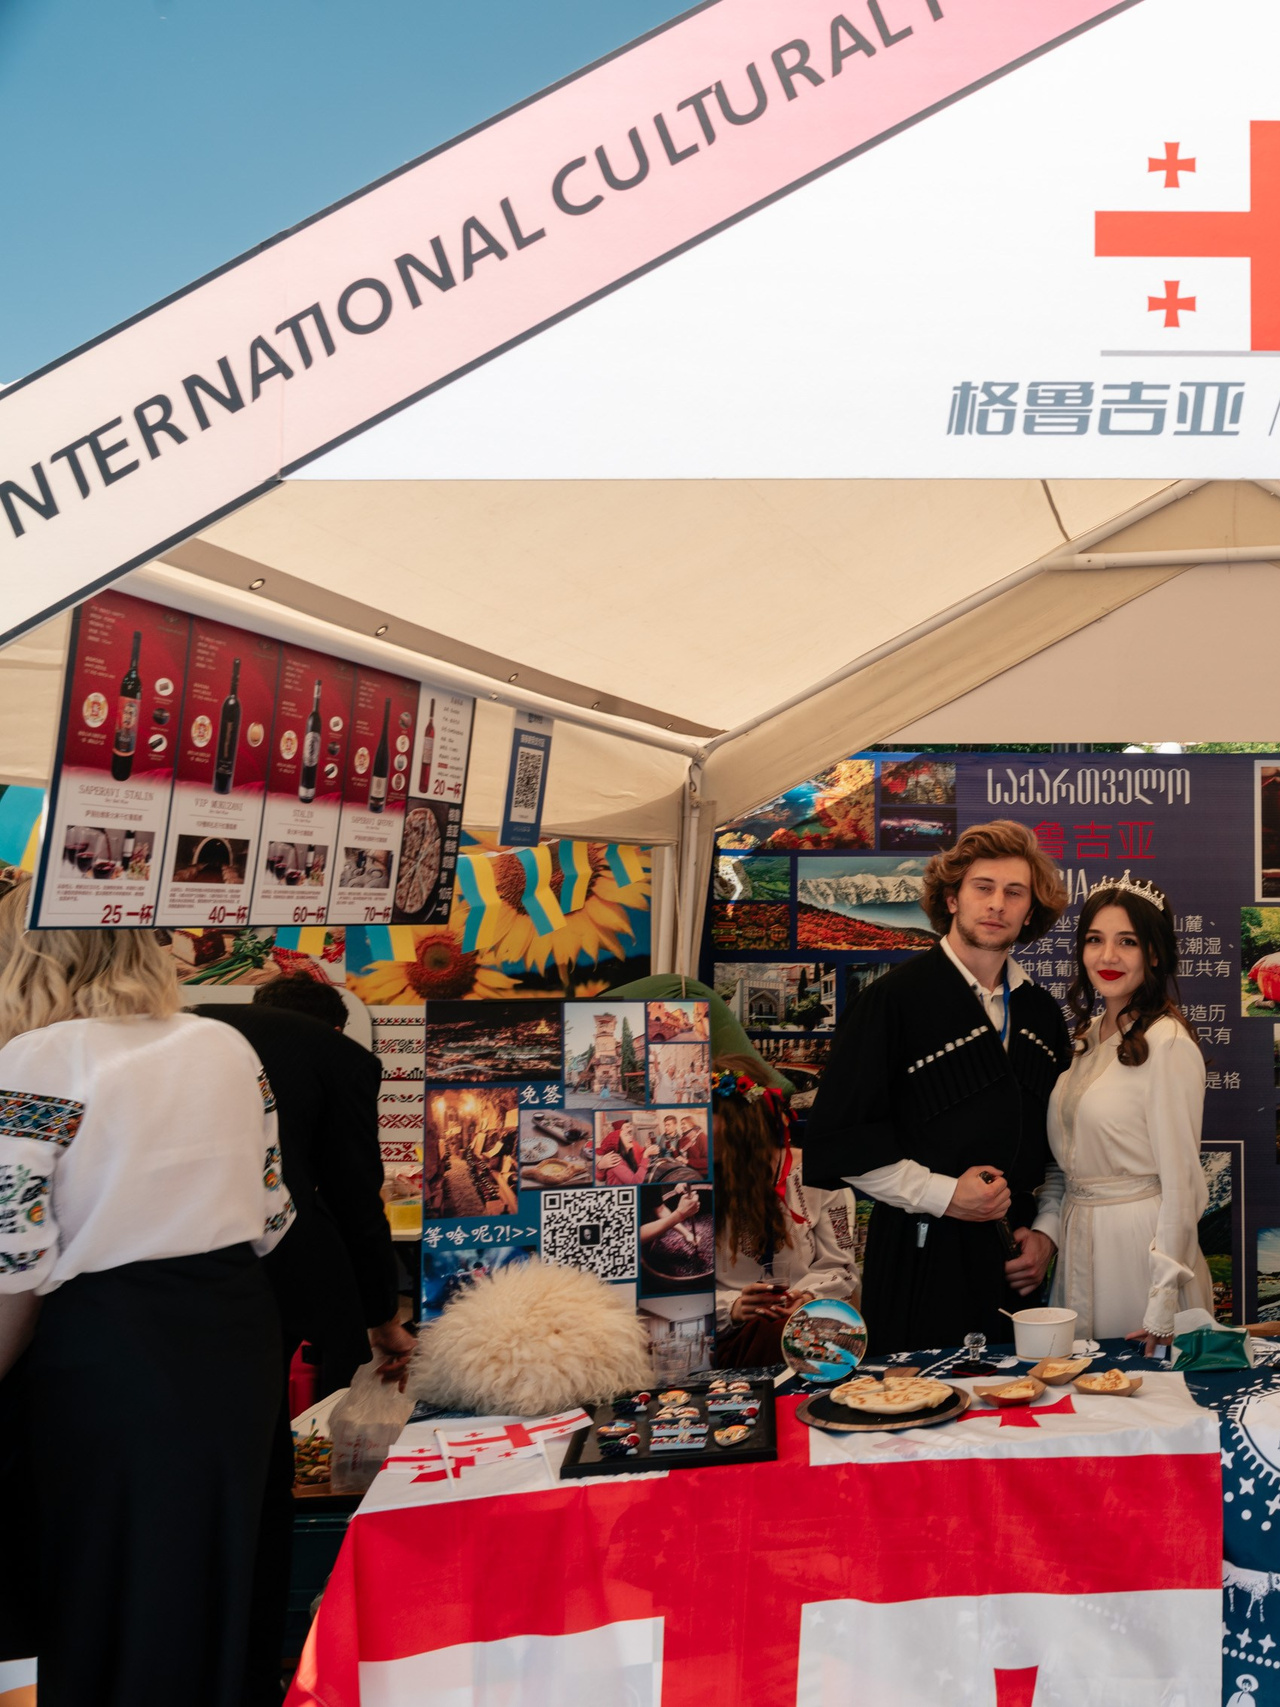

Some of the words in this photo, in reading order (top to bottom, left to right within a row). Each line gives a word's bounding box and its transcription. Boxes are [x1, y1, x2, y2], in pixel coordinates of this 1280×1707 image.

[551, 0, 914, 217] CULTURAL
[946, 381, 1246, 437] 格鲁吉亚
[987, 768, 1191, 805] საქართველო
[101, 904, 123, 925] 25
[519, 1084, 564, 1106] 免签
